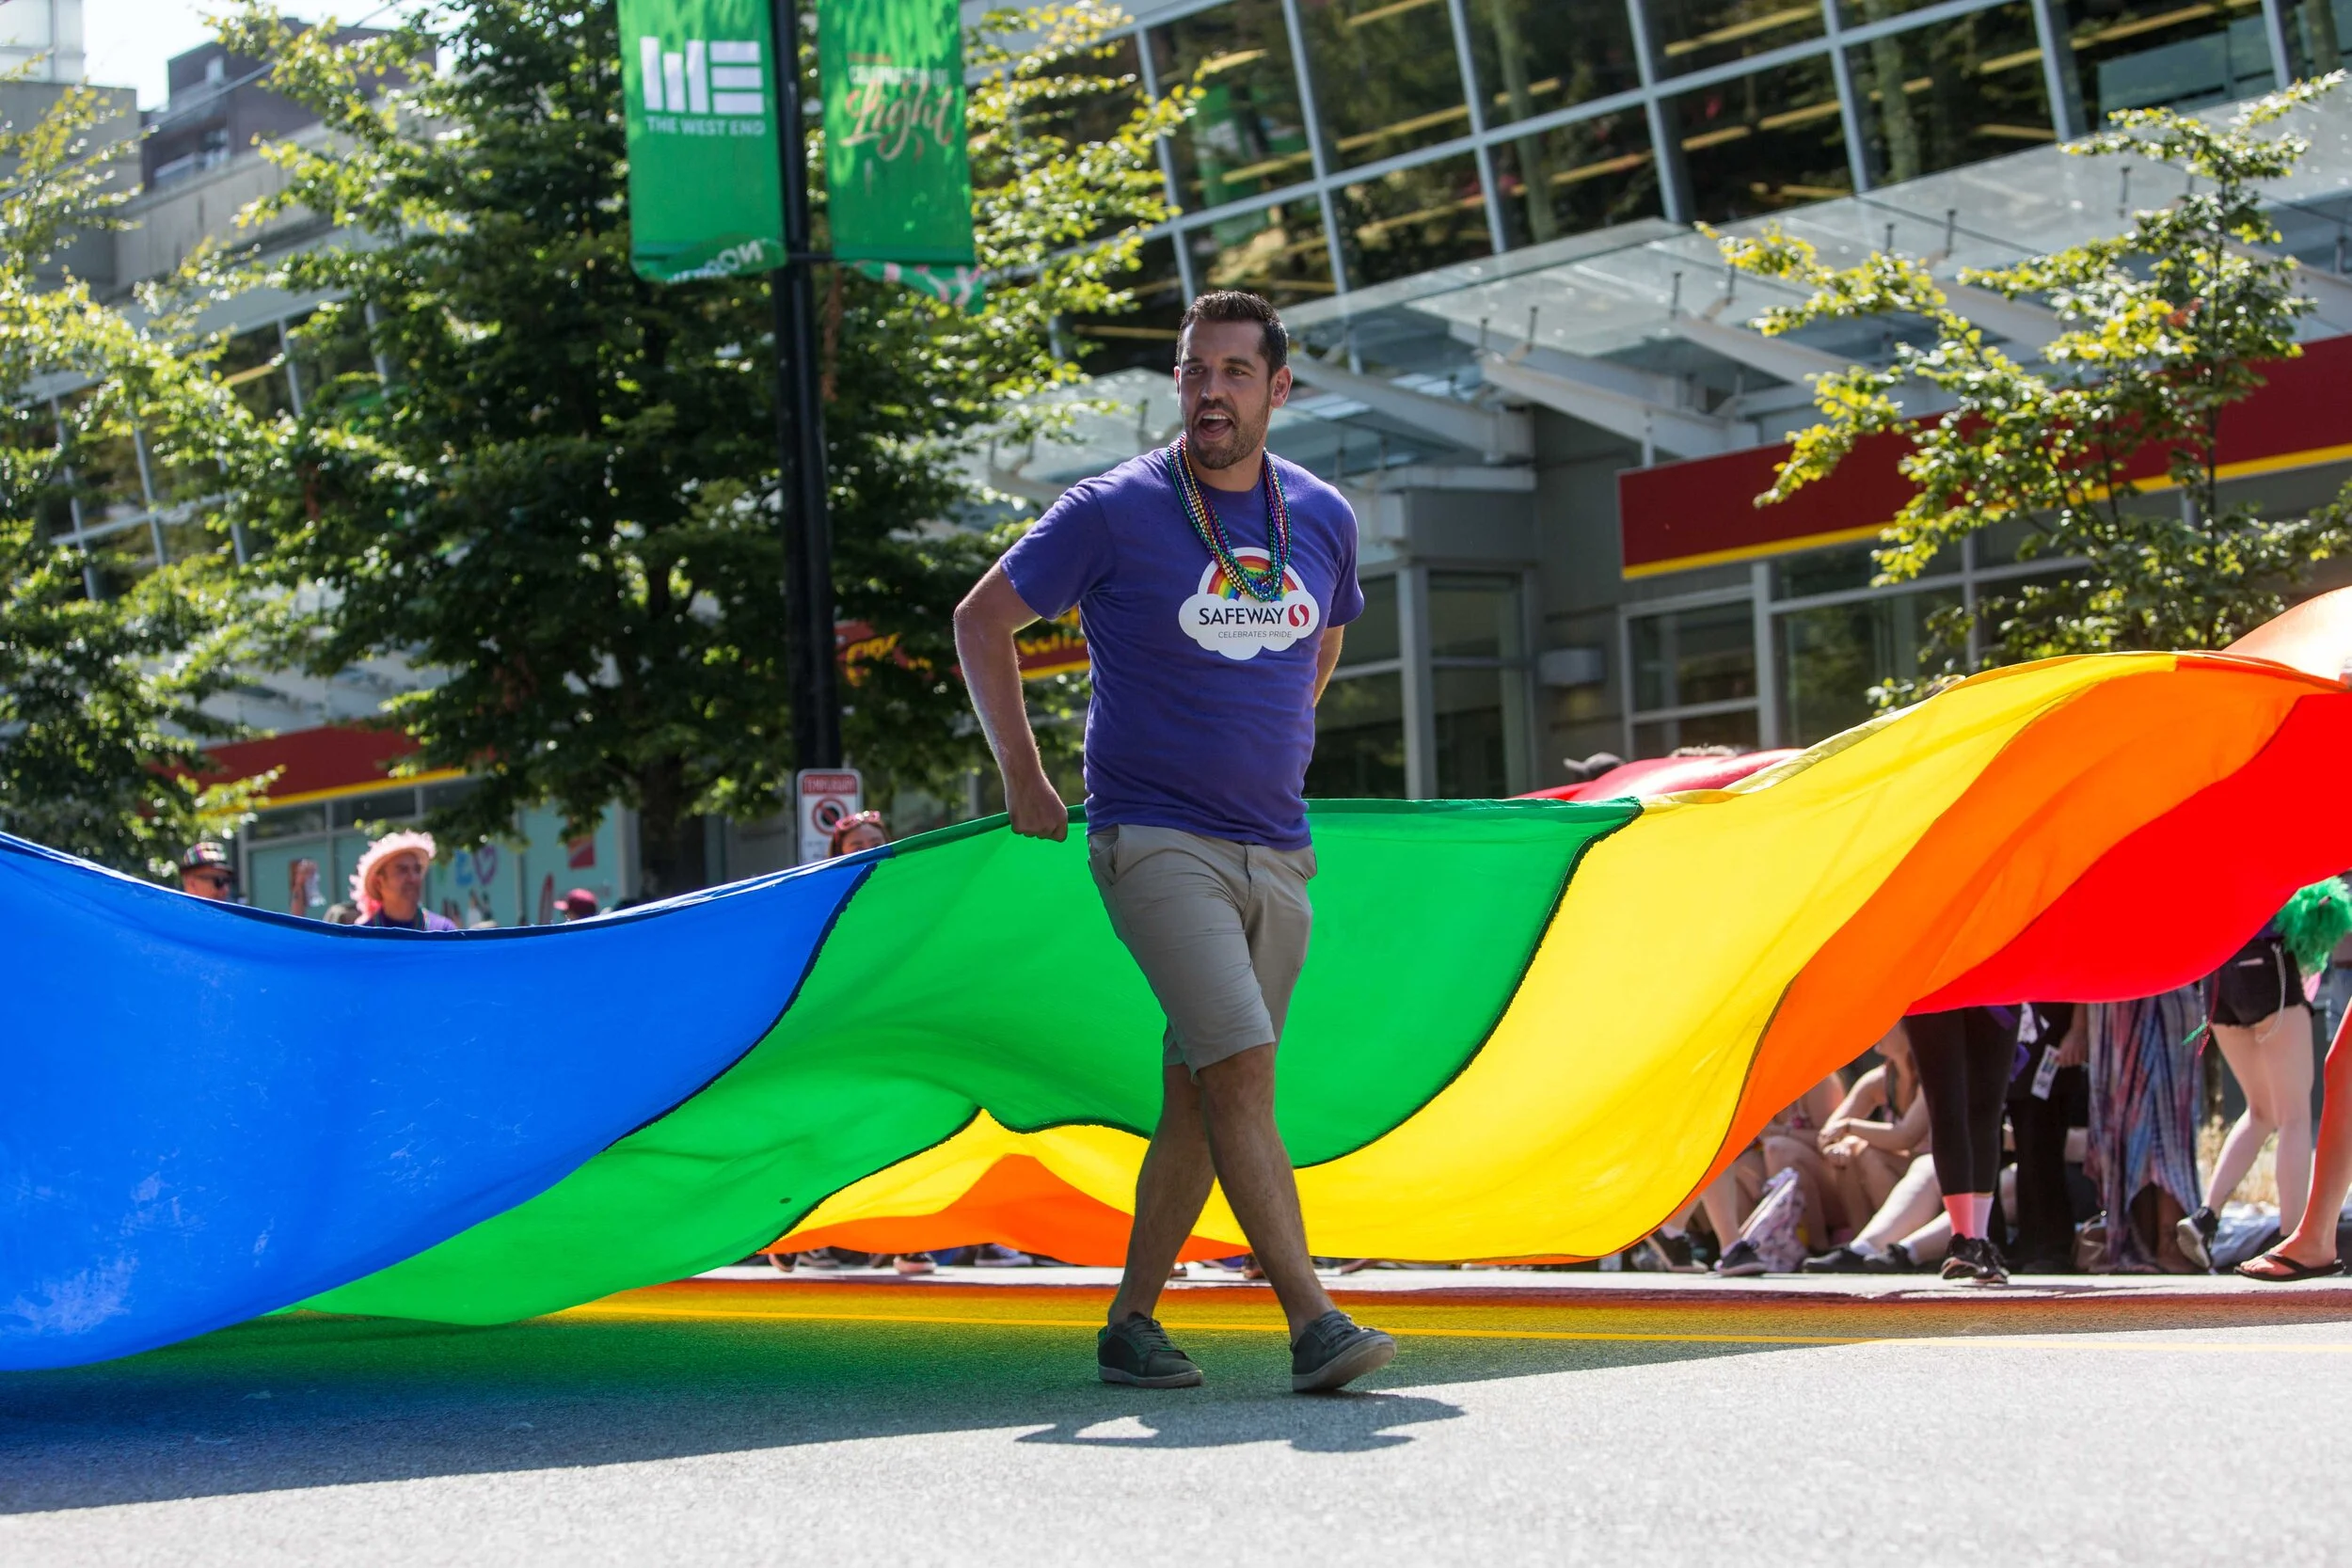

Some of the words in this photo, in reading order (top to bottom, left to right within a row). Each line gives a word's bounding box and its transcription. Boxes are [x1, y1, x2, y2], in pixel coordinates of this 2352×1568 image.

[646, 117, 677, 134] THE
[680, 119, 726, 135] WEST
[729, 119, 766, 136] END
[838, 75, 953, 162] Light
[1199, 607, 1285, 626] SAFEWAY
[1217, 630, 1267, 639] CELEBRATES
[1268, 630, 1293, 639] PRIDE
